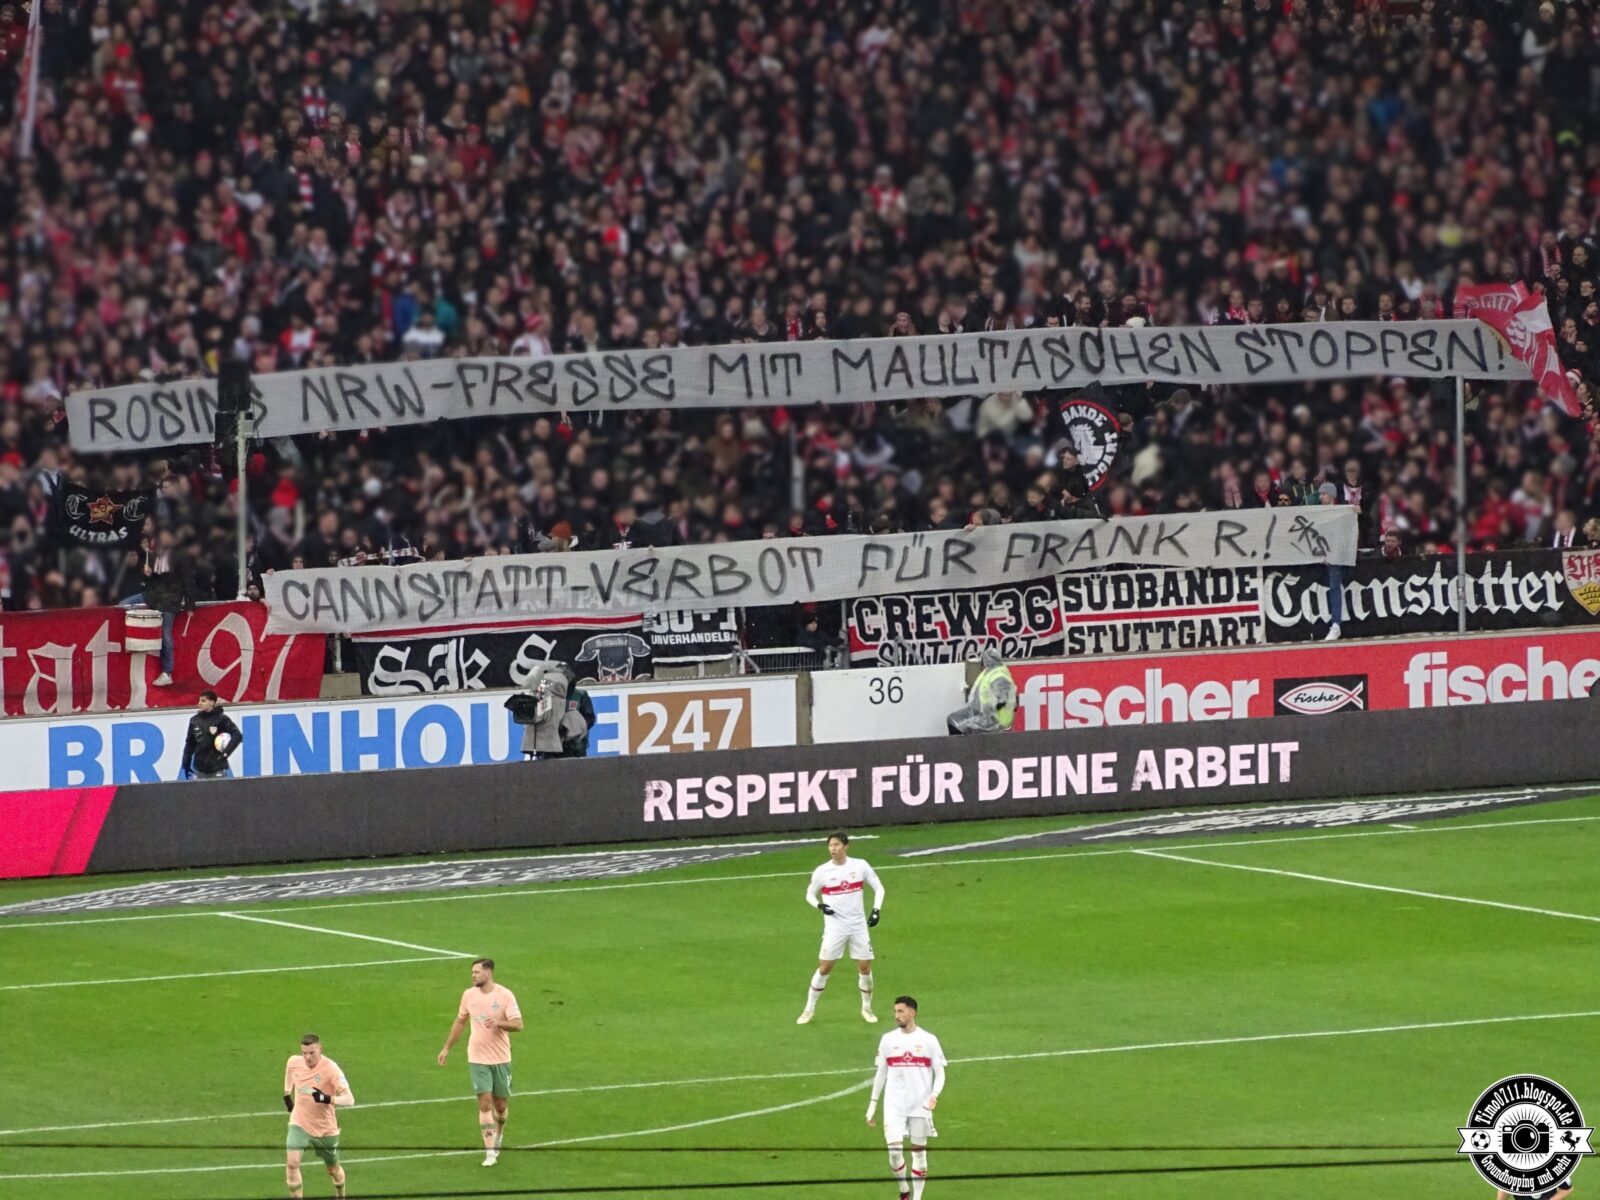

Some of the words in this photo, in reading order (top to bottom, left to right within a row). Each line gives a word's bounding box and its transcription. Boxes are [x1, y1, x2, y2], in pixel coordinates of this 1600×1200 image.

[302, 353, 675, 422] NRW-FRESSE
[708, 352, 801, 398] MIT
[833, 331, 1221, 393] MAULTASCHEN
[1235, 327, 1505, 374] STOPFEN!
[69, 524, 128, 543] ULTRAS
[282, 547, 822, 622] CANNSTATT-VERBOT
[859, 534, 977, 588] FÜR
[1003, 523, 1190, 573] FRANK
[1062, 566, 1259, 611] SÜDBANDE
[853, 591, 992, 643] CREW
[992, 585, 1054, 635] 36
[1068, 615, 1260, 654] STUTTGART
[869, 677, 903, 704] 36
[1018, 669, 1259, 730] fischer
[1294, 692, 1343, 703] fischer
[49, 695, 619, 788] BRINHOUE
[636, 698, 744, 754] 247
[644, 767, 857, 822] RESPEKT
[872, 755, 964, 808] FÜR
[977, 752, 1117, 802] DEINE
[1131, 741, 1299, 792] ARBEIT
